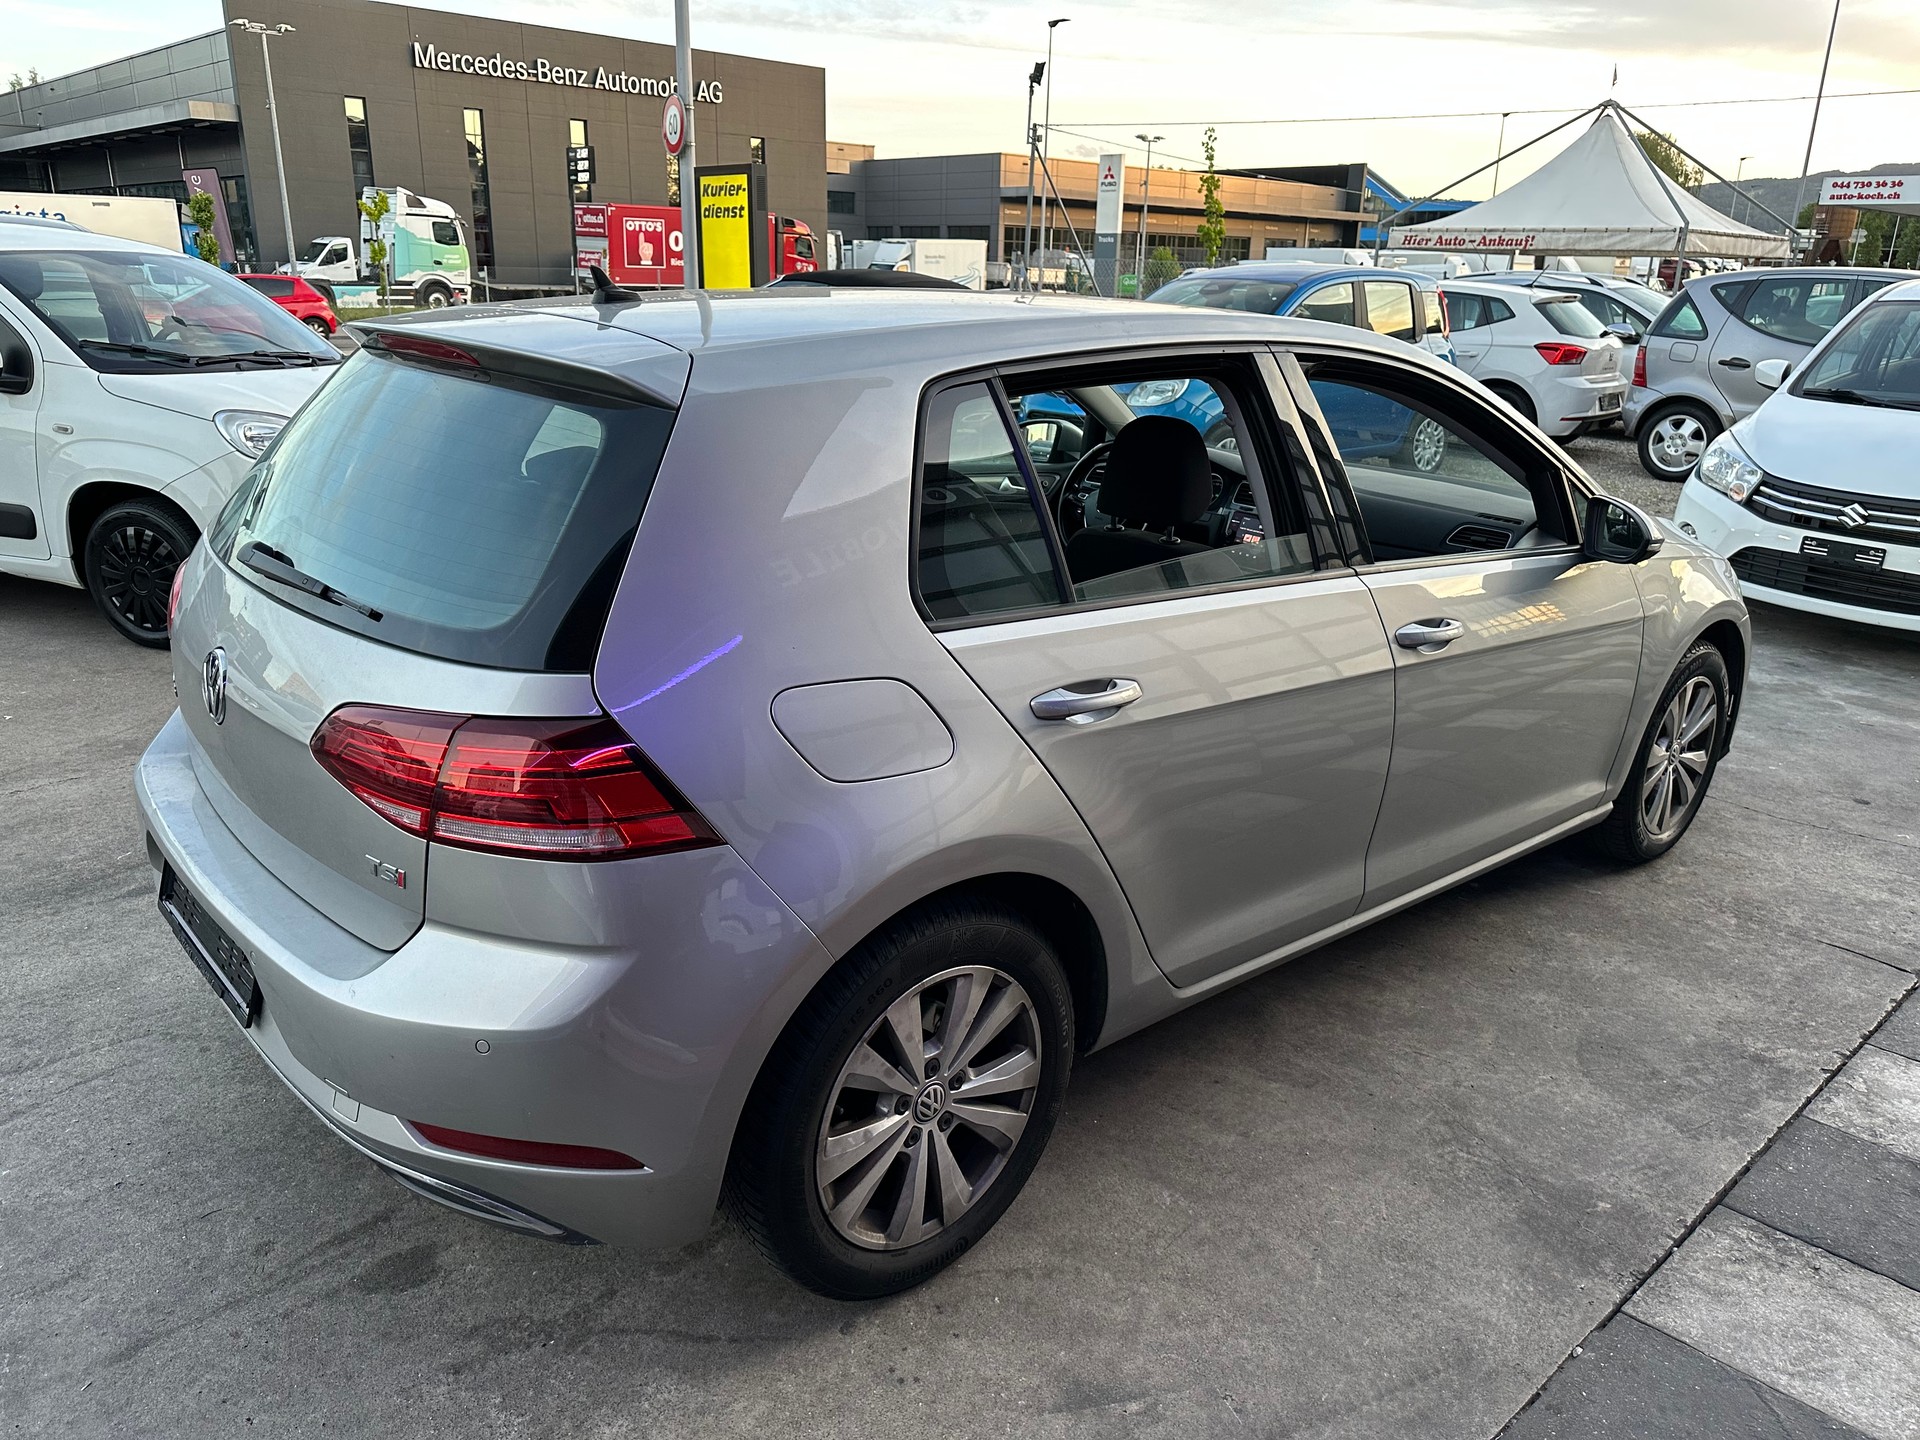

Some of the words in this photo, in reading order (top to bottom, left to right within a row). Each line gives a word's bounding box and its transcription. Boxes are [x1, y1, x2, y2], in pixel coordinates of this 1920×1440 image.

[412, 41, 589, 88] Mercedes-Benz
[594, 66, 679, 98] Automob
[697, 80, 723, 103] AG
[668, 113, 678, 136] 60
[702, 181, 746, 198] Kurier-
[1832, 181, 1851, 189] 044
[1853, 180, 1872, 190] 730
[1873, 180, 1888, 189] 36
[1889, 180, 1904, 189] 36
[1829, 192, 1901, 201] auto-koch.ch
[703, 204, 745, 219] dienst
[625, 220, 663, 232] OTTO'S
[1401, 234, 1432, 247] Hier
[1433, 234, 1466, 247] Auto
[365, 854, 406, 890] TSI
[865, 974, 895, 1007] 860
